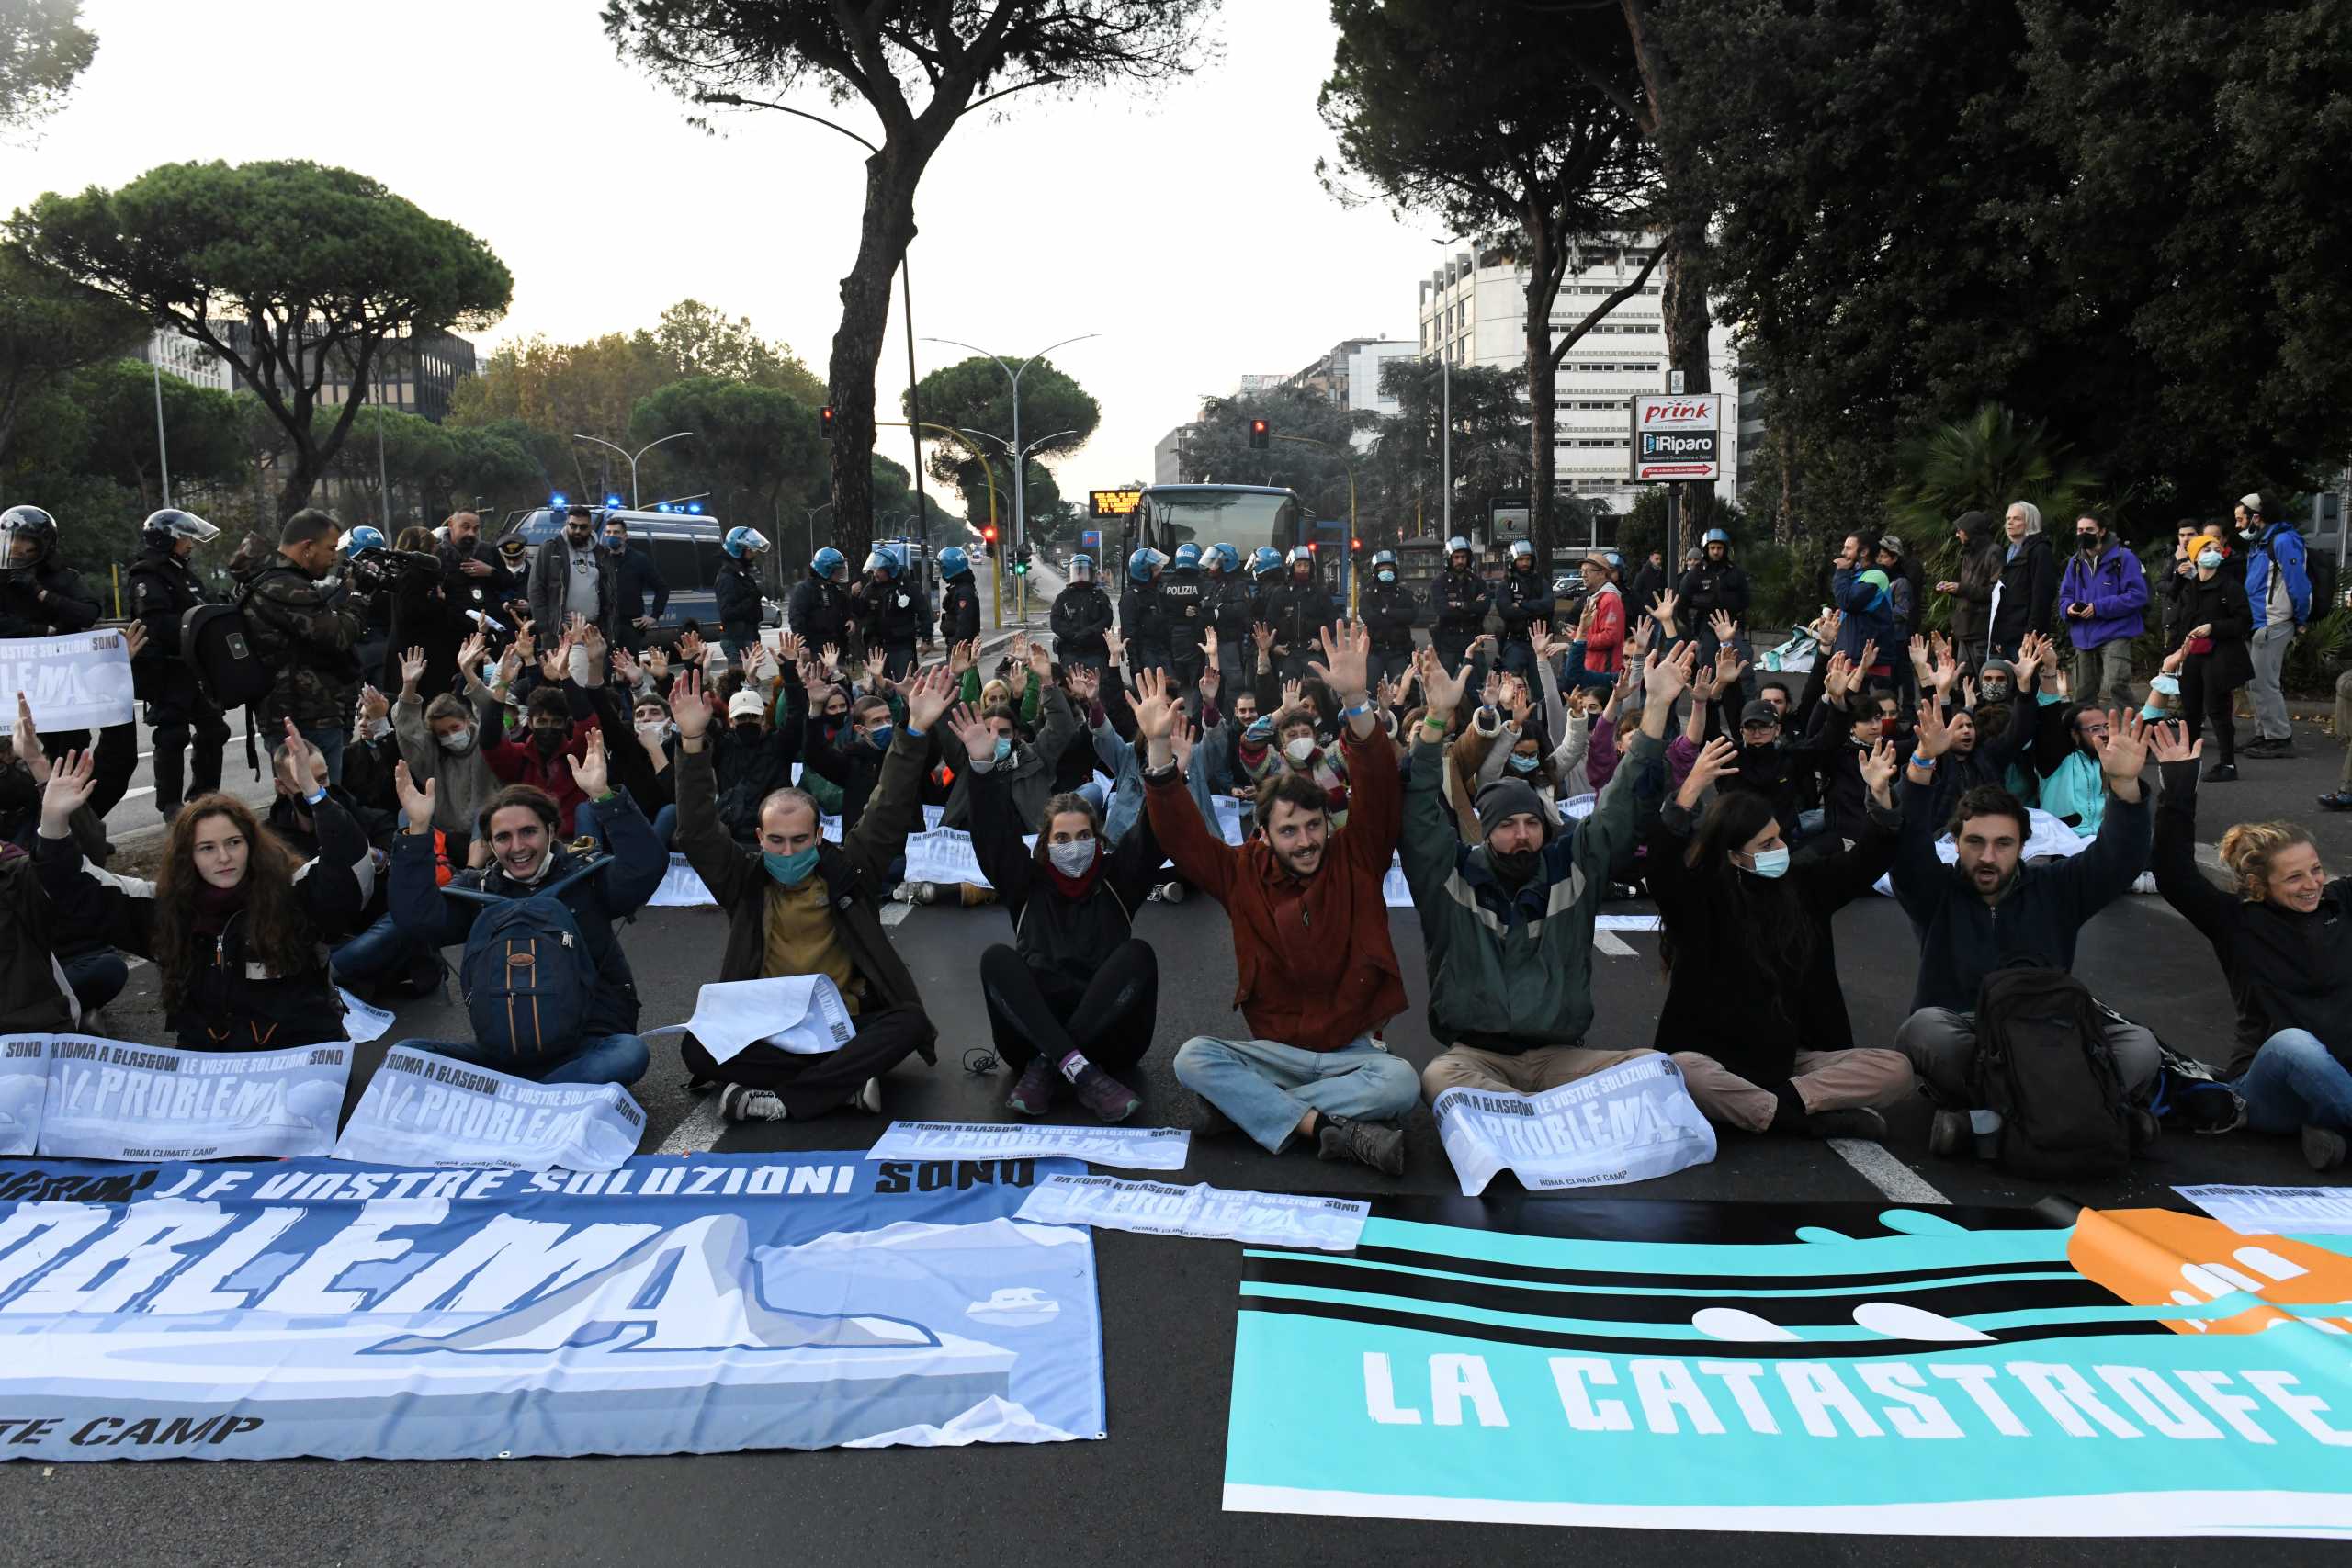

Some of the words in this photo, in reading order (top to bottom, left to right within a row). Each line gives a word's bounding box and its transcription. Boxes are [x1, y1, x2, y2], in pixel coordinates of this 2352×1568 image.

[1645, 403, 1712, 423] prink
[1656, 436, 1712, 454] iRiparo
[1167, 585, 1198, 595] POLIZIA
[92, 636, 119, 650] SONO
[922, 830, 943, 840] ROMA
[671, 857, 692, 867] ROM
[830, 1021, 850, 1043] SONO
[6, 1041, 42, 1058] SONO
[60, 1042, 96, 1060] ROMA
[98, 1046, 109, 1062] A
[111, 1048, 179, 1071] GLASGOW
[182, 1057, 199, 1075] LE
[199, 1056, 246, 1075] VOSTRE
[249, 1054, 309, 1073] SOLUZIONI
[309, 1050, 344, 1066] SONO
[93, 1066, 290, 1126] PROBLEMA
[387, 1054, 424, 1076] ROMA
[424, 1061, 436, 1079] A
[435, 1066, 499, 1095] GLASGOW
[499, 1082, 516, 1100] LE
[515, 1087, 562, 1107] VOSTRE
[615, 1097, 641, 1126] SONO
[1440, 1092, 1472, 1114] ROMA
[1471, 1095, 1481, 1111] A
[1482, 1097, 1535, 1117] GLASGOW
[1535, 1097, 1552, 1114] LE
[1551, 1081, 1600, 1109] VOSTRE
[1599, 1061, 1661, 1094] SOLUZIONI
[916, 1123, 952, 1132] ROMA
[1041, 1126, 1085, 1135] VOSTRE
[1087, 1128, 1148, 1137] SOLUZIONI
[1150, 1129, 1182, 1138] SONO
[1481, 1089, 1680, 1155] PROBLEMA
[123, 1148, 151, 1157] ROMA
[153, 1147, 190, 1157] CLIMATE
[192, 1146, 217, 1156] CAMP
[951, 1132, 1135, 1156] PROBLEMA
[251, 1169, 513, 1200] VOSTRE
[519, 1165, 855, 1195] SOLUZIONI
[875, 1159, 1036, 1194] SONO
[1539, 1179, 1565, 1187] ROMA
[1566, 1175, 1601, 1185] CLIMATE
[1603, 1169, 1628, 1181] CAMP
[1073, 1177, 1113, 1186] ROMA
[1114, 1181, 1123, 1190] A
[1125, 1181, 1187, 1196] GLASGOW
[1254, 1194, 1321, 1208] SOLUZIONI
[1324, 1200, 1360, 1212] SONO
[2205, 1187, 2246, 1196] ROMA
[2259, 1188, 2325, 1198] GLASGOW
[1363, 1351, 1510, 1427] LA
[1547, 1356, 2352, 1447] CATASTROFE
[69, 1413, 265, 1446] CAMP
